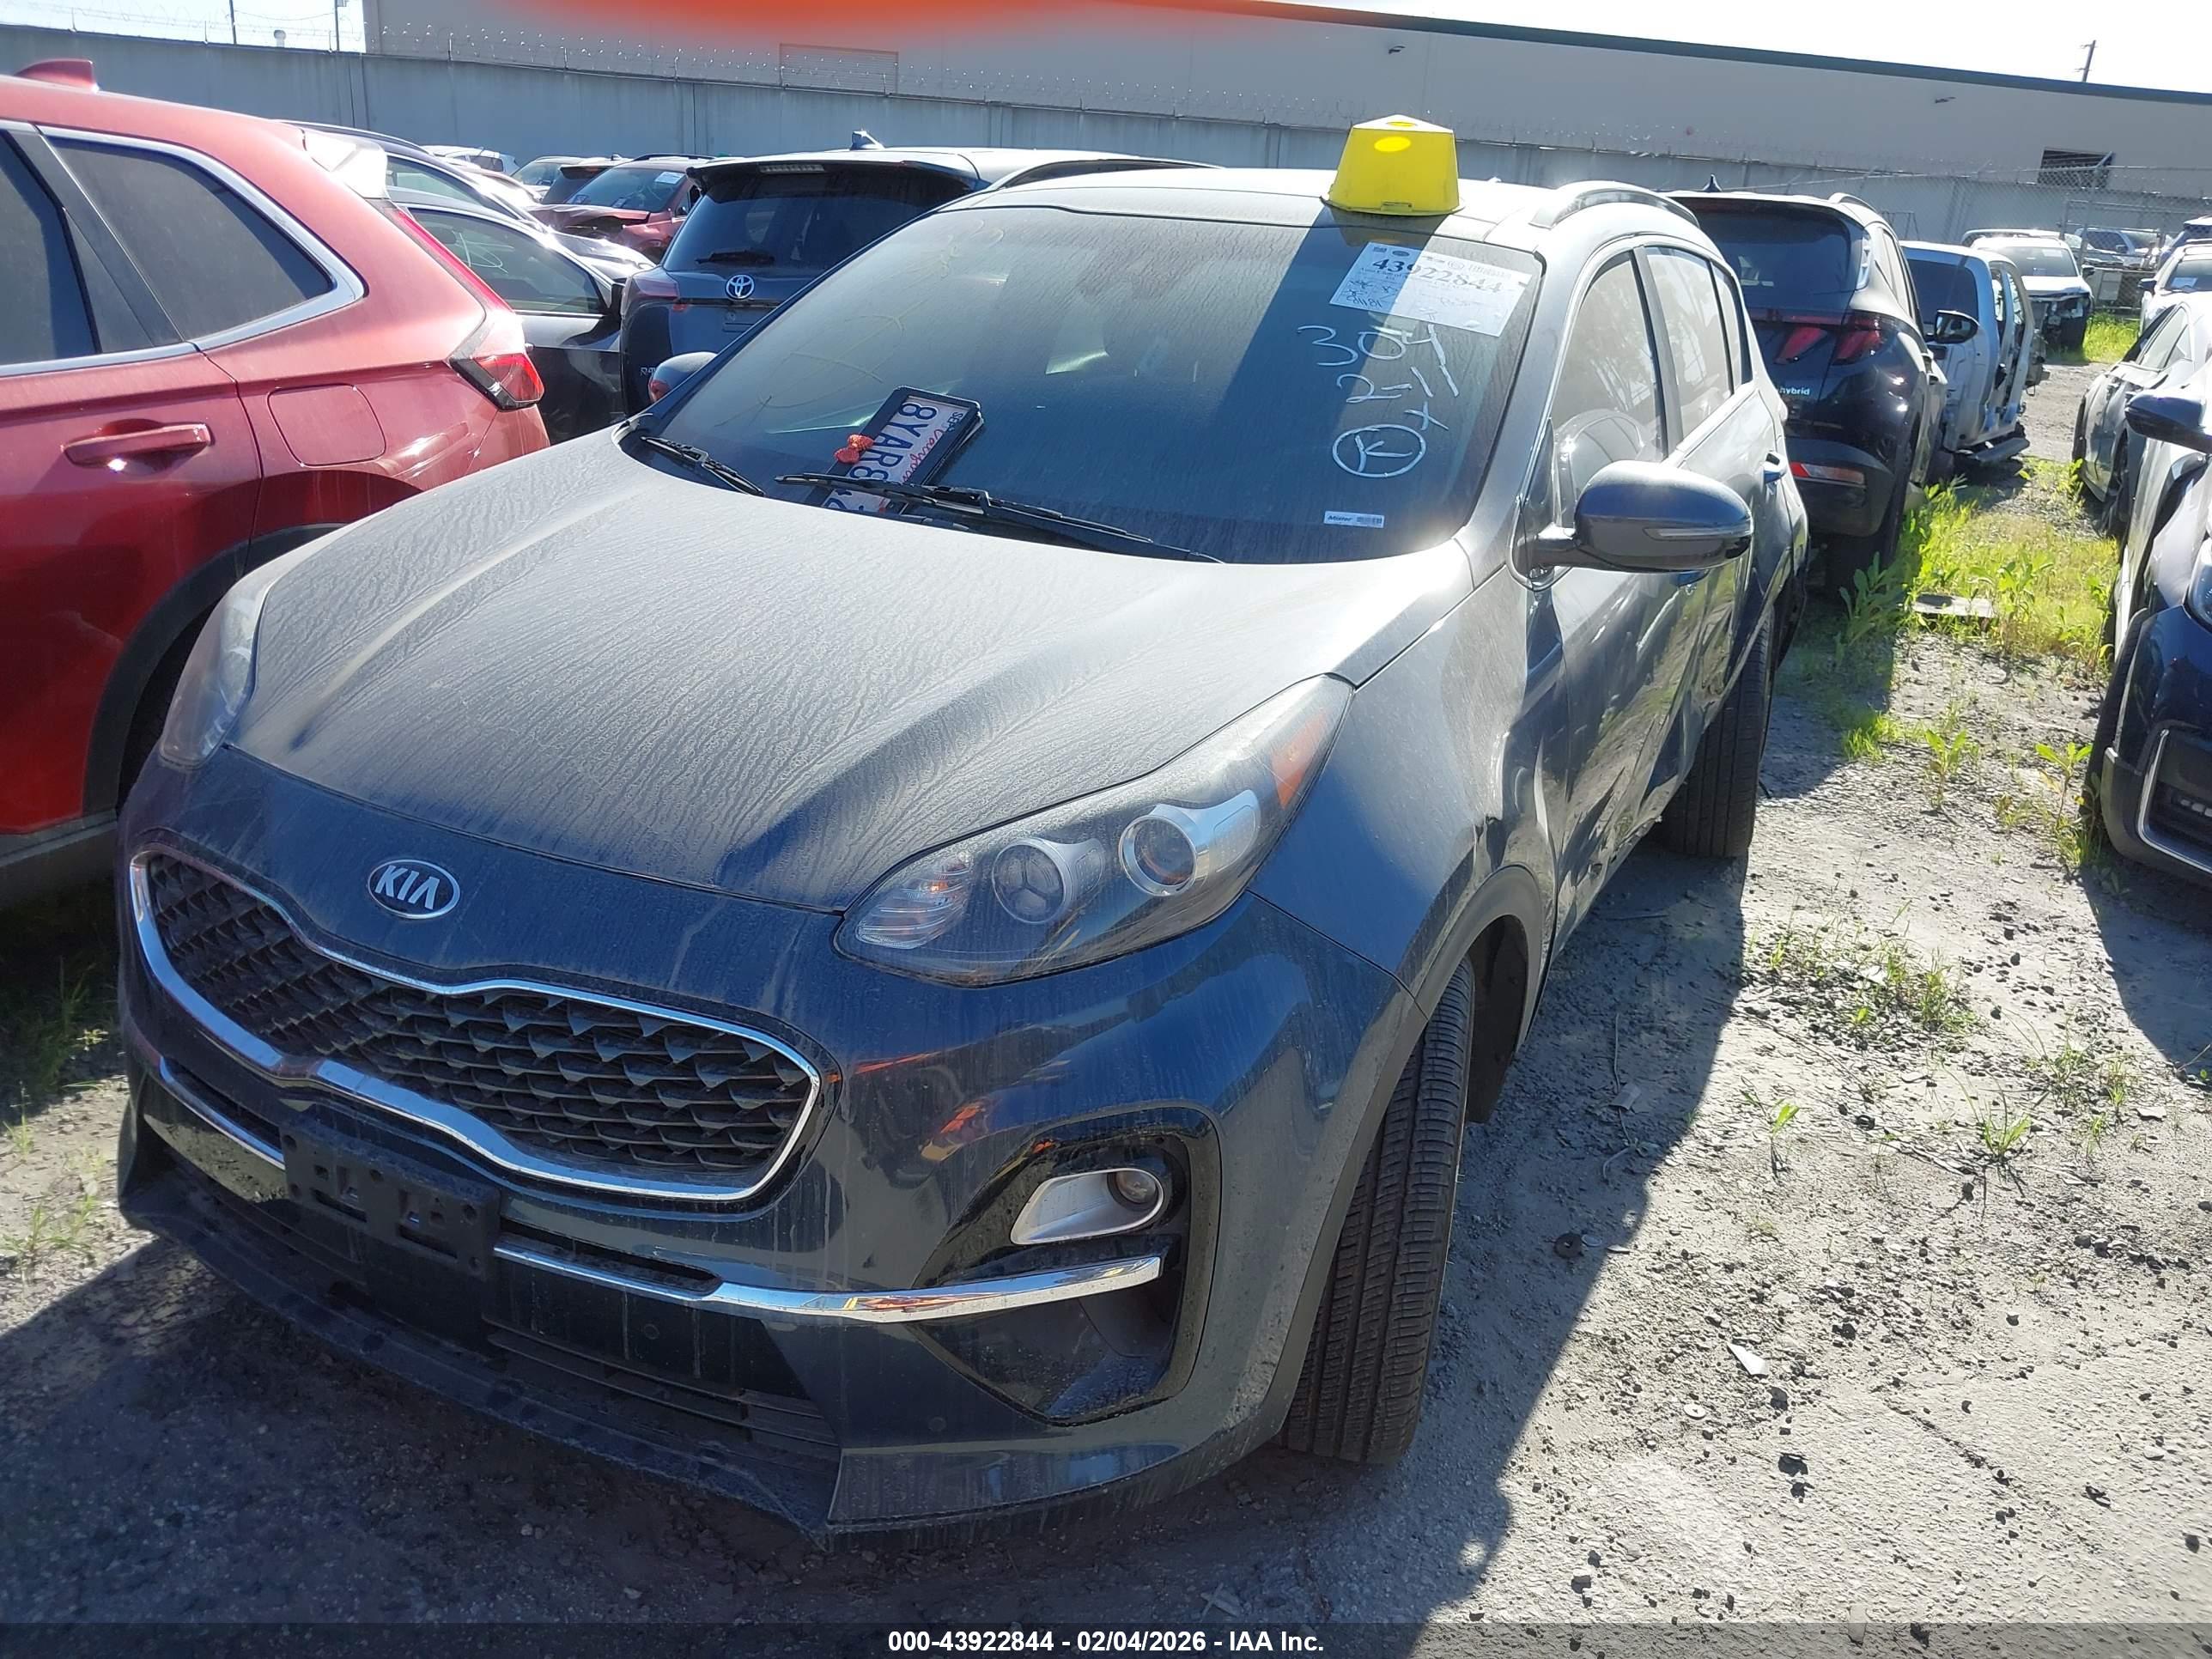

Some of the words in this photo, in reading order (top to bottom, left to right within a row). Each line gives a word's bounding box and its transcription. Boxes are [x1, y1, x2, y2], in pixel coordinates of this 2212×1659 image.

[1372, 258, 1502, 294] 43922844
[1778, 386, 1810, 396] hybrid
[374, 865, 440, 910] KIA
